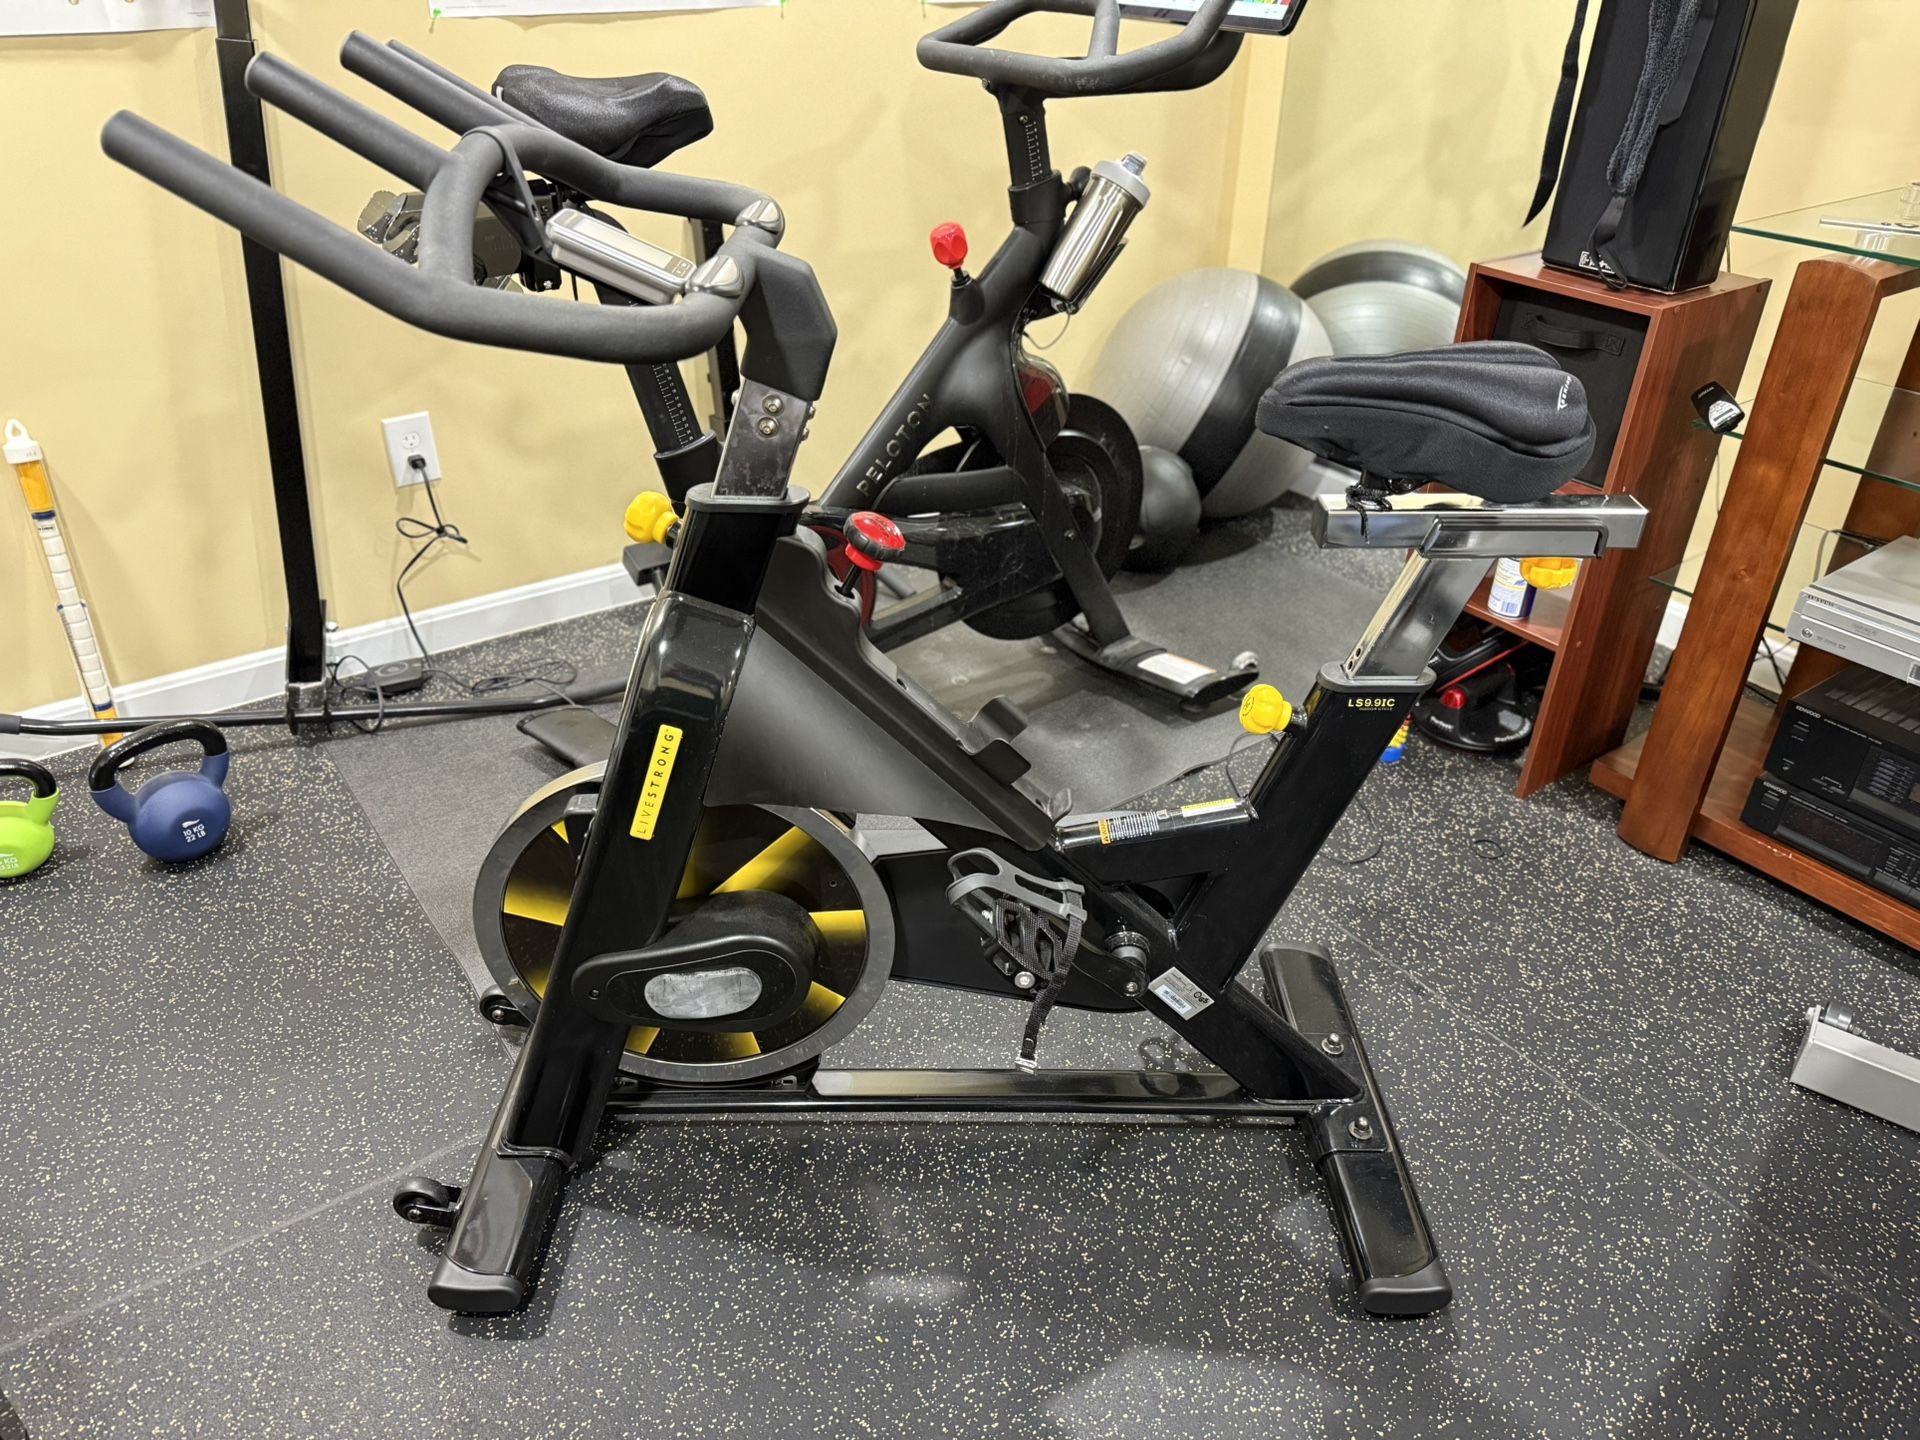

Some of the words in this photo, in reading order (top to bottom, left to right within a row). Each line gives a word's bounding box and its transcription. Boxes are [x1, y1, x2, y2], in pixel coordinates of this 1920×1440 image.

[856, 393, 930, 497] PELOTON
[1348, 698, 1396, 707] LS9.9IC
[1795, 704, 1821, 719] KENWOOD
[637, 733, 675, 835] LIVESTRONG
[1763, 780, 1788, 795] KENWOOD
[183, 829, 192, 837] 10
[193, 824, 205, 834] KG
[186, 834, 196, 843] 22
[197, 830, 206, 838] LB
[4, 856, 18, 865] KG
